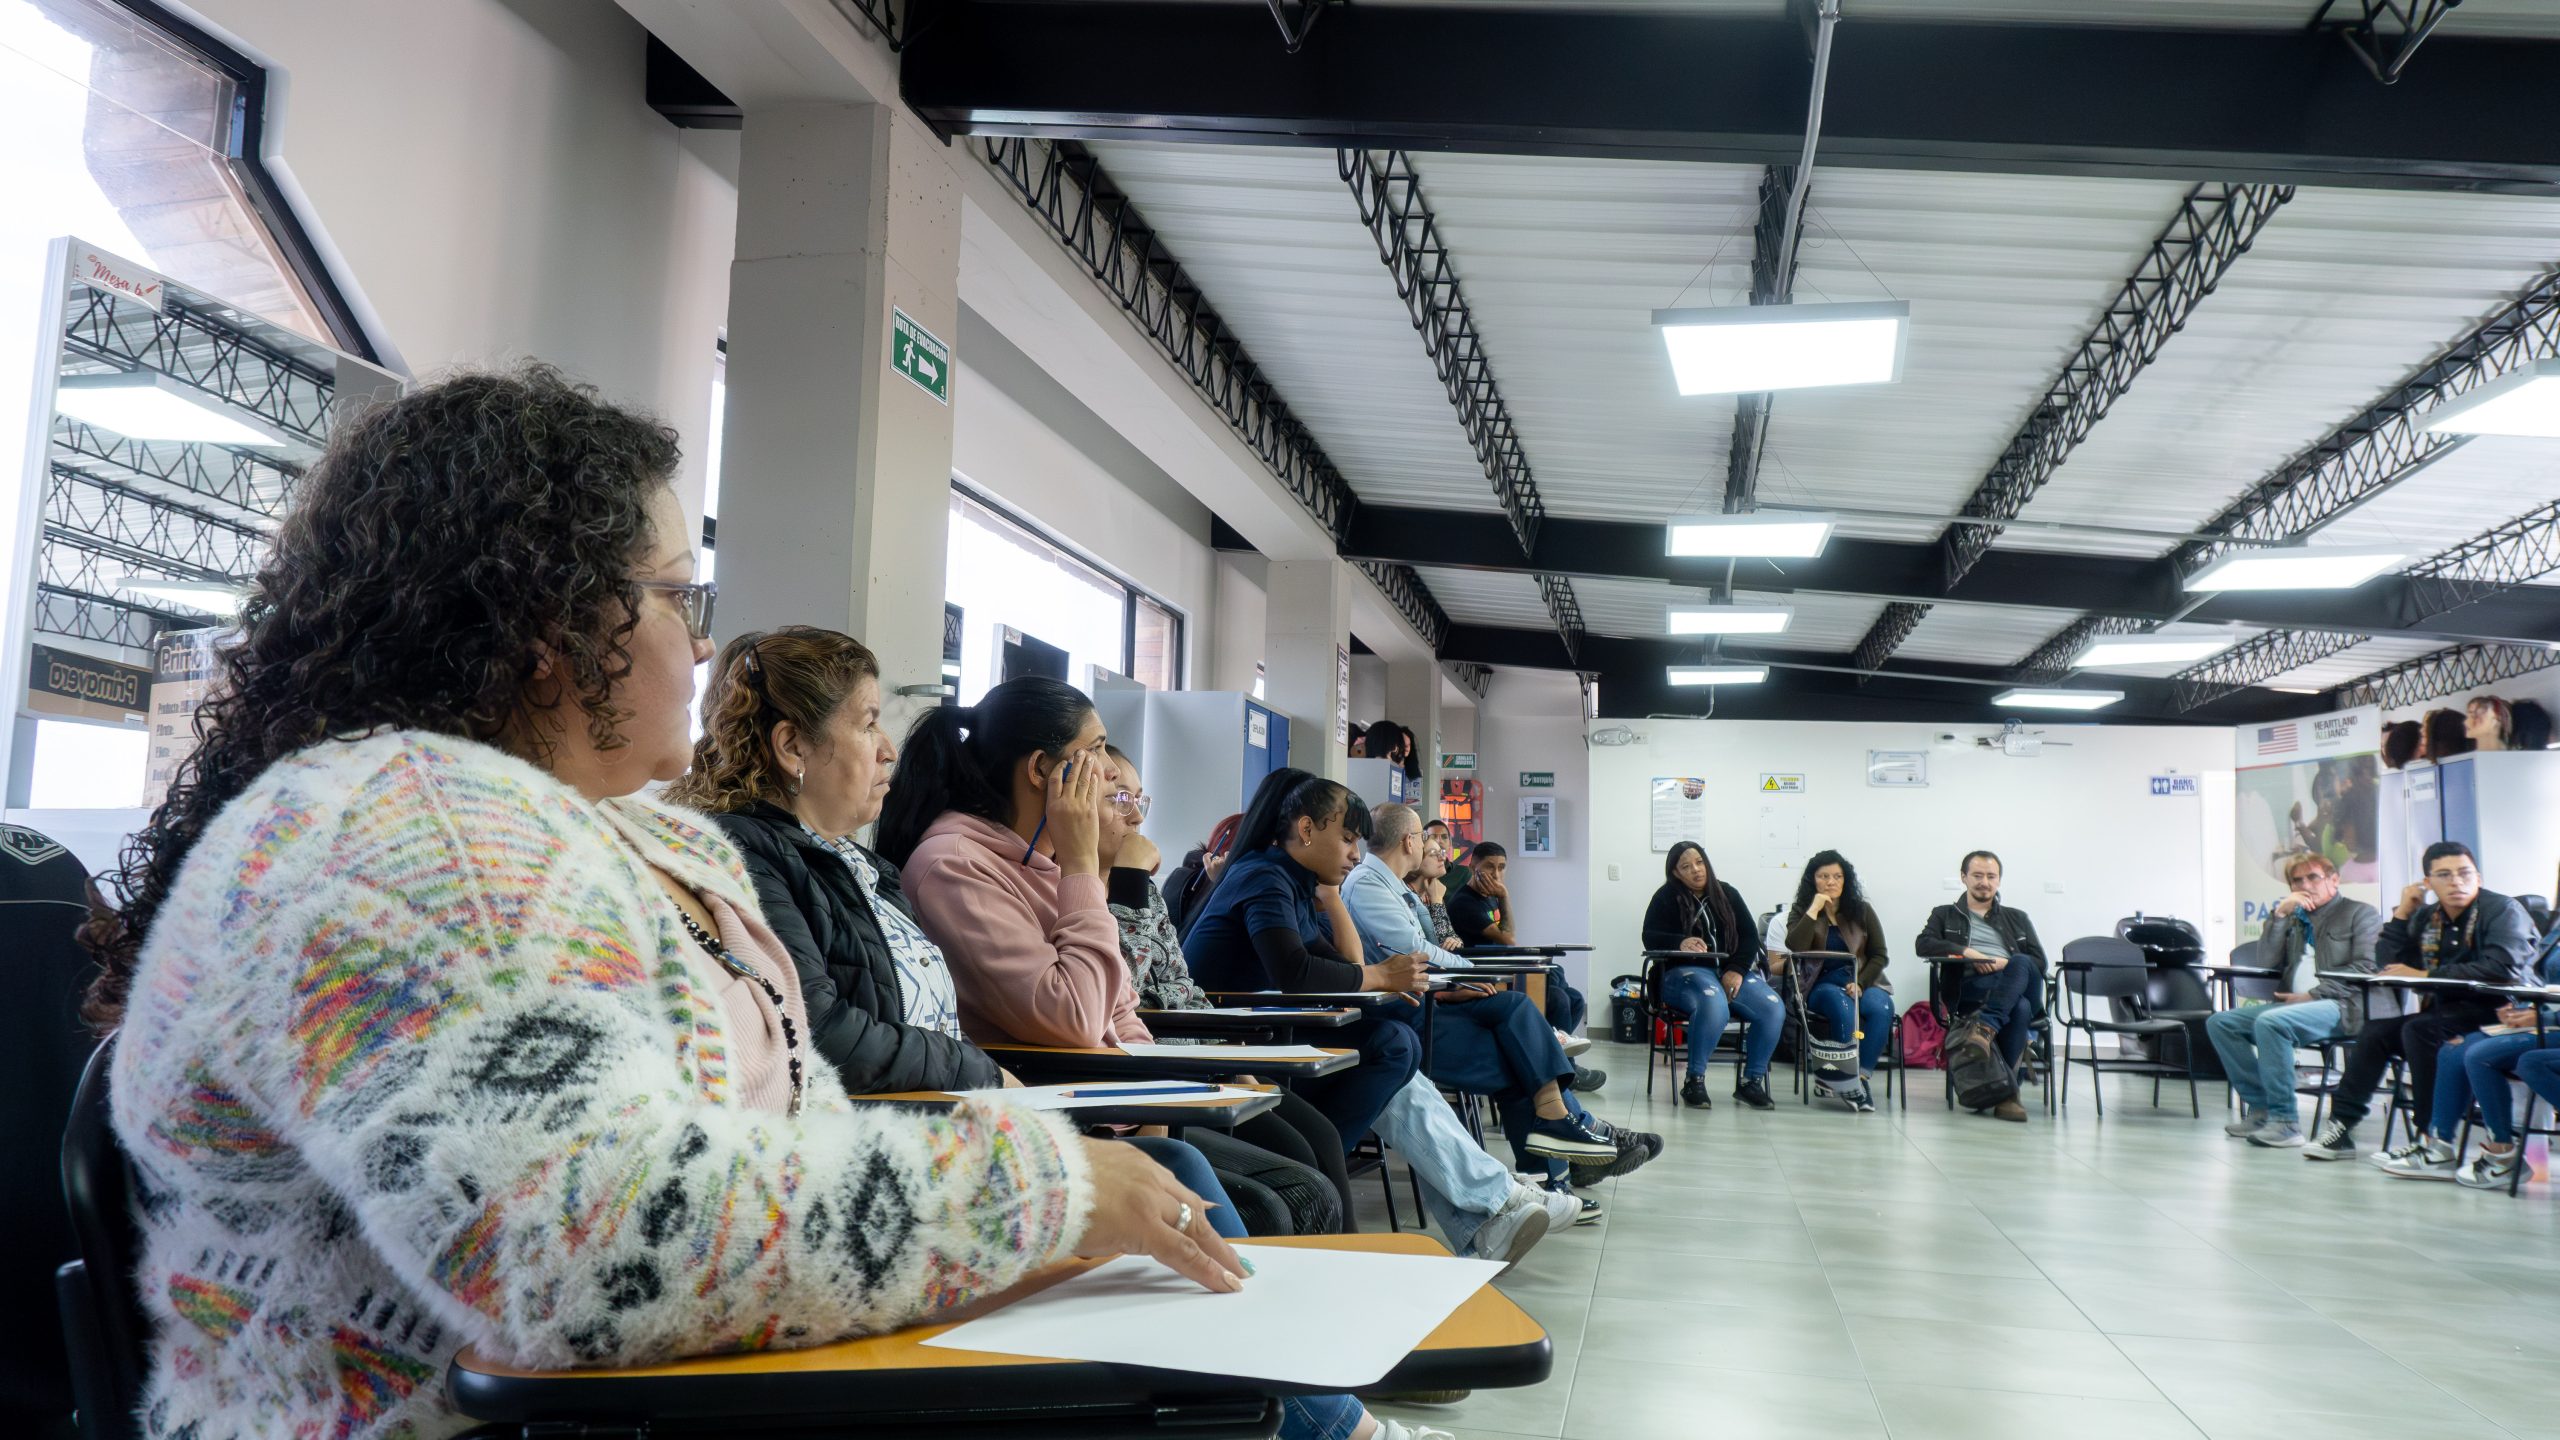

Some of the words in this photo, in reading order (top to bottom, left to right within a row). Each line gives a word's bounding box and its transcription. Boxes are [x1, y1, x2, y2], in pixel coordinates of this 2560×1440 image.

[93, 261, 131, 291] Mesa
[895, 314, 909, 337] RUTA
[909, 324, 917, 342] DE
[2314, 715, 2358, 731] HEARTLAND
[2315, 727, 2350, 741] ALLIANCE
